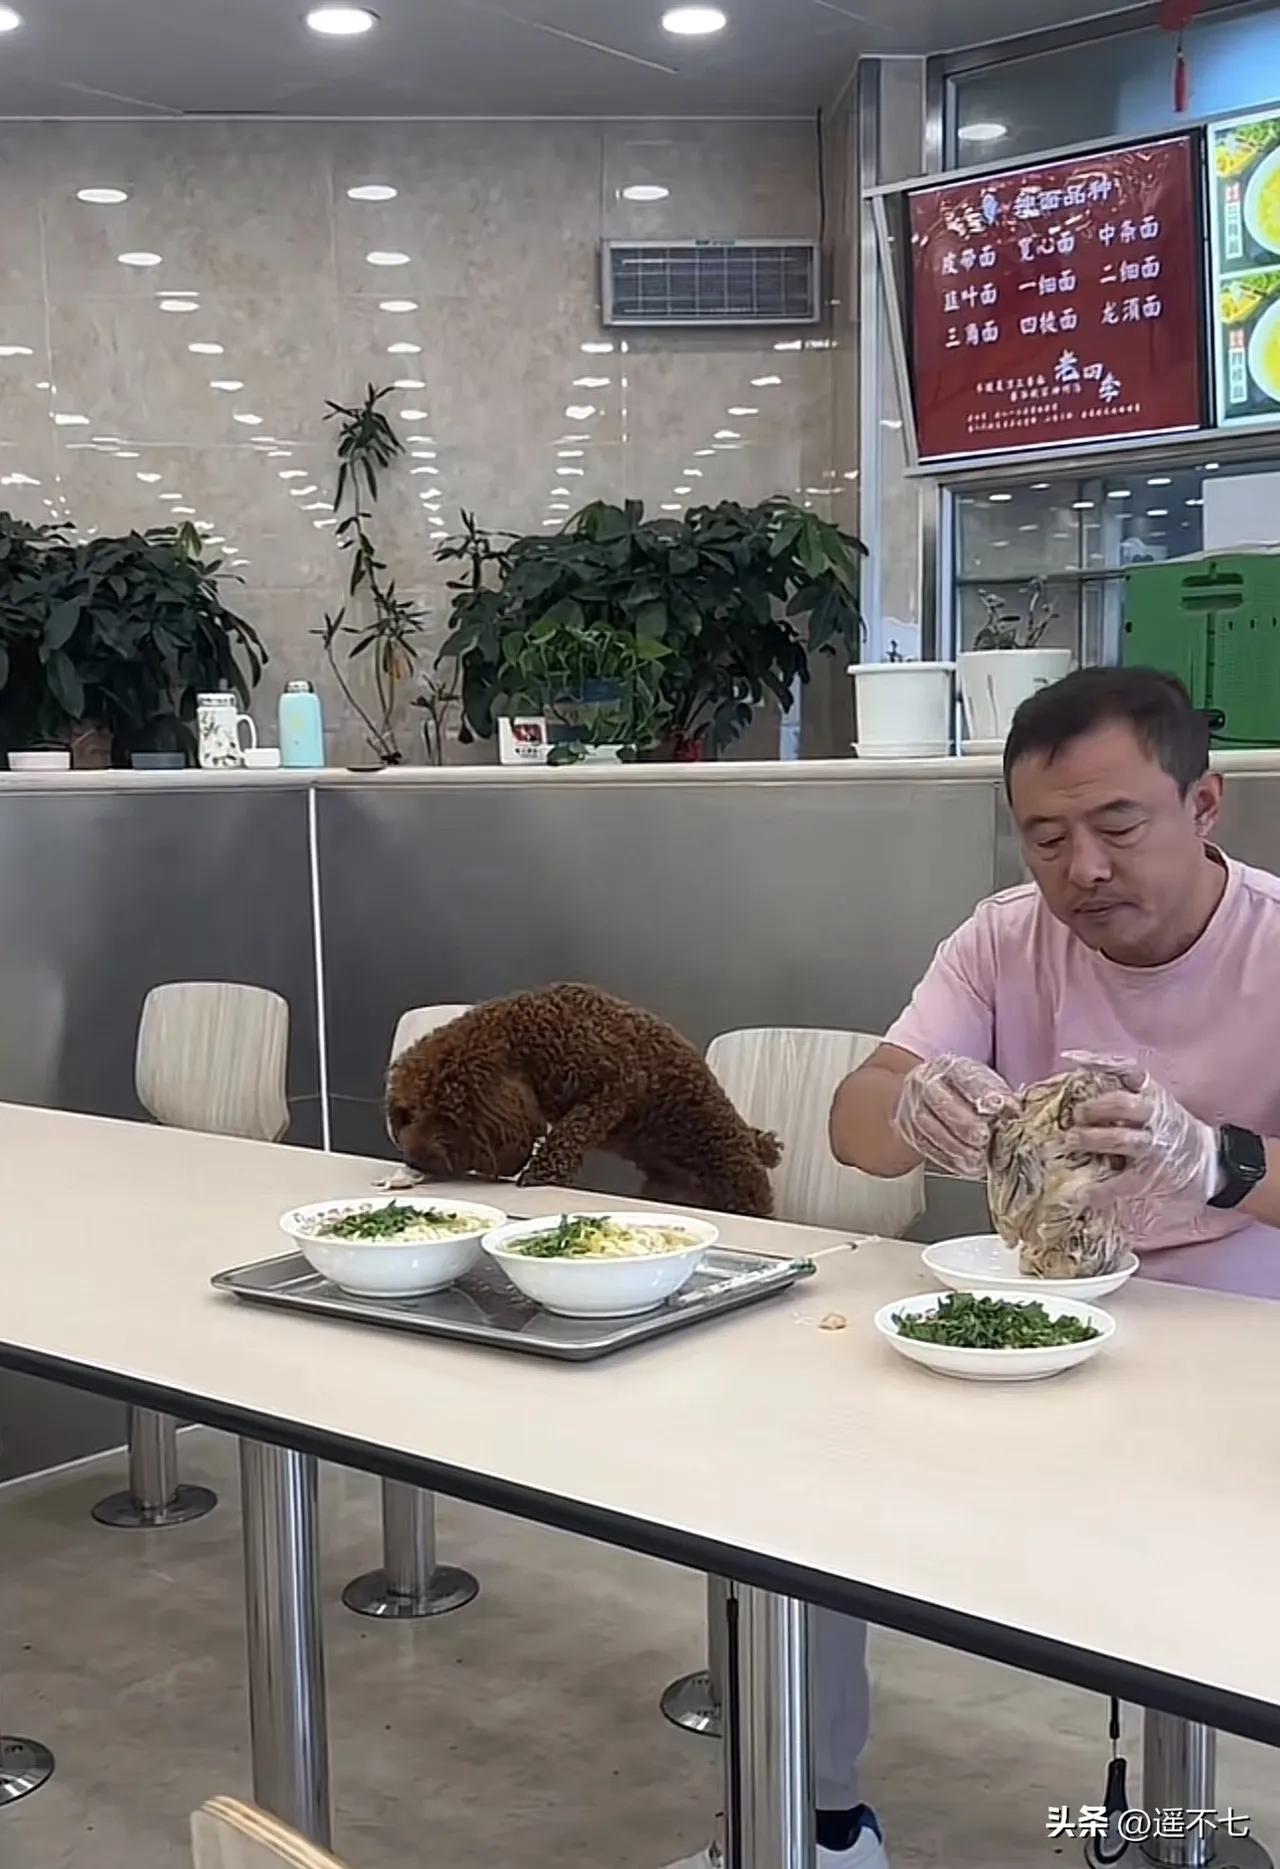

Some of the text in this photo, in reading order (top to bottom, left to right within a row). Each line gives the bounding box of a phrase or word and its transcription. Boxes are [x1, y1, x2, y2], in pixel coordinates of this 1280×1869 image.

[1099, 215, 1159, 247] 中条面
[942, 245, 996, 275] 皮带面
[1100, 255, 1160, 284] 二细面
[944, 282, 998, 312] 韭叶面
[1018, 269, 1077, 296] 一细面
[1101, 294, 1161, 324] 龙须面
[945, 319, 999, 348] 三角面
